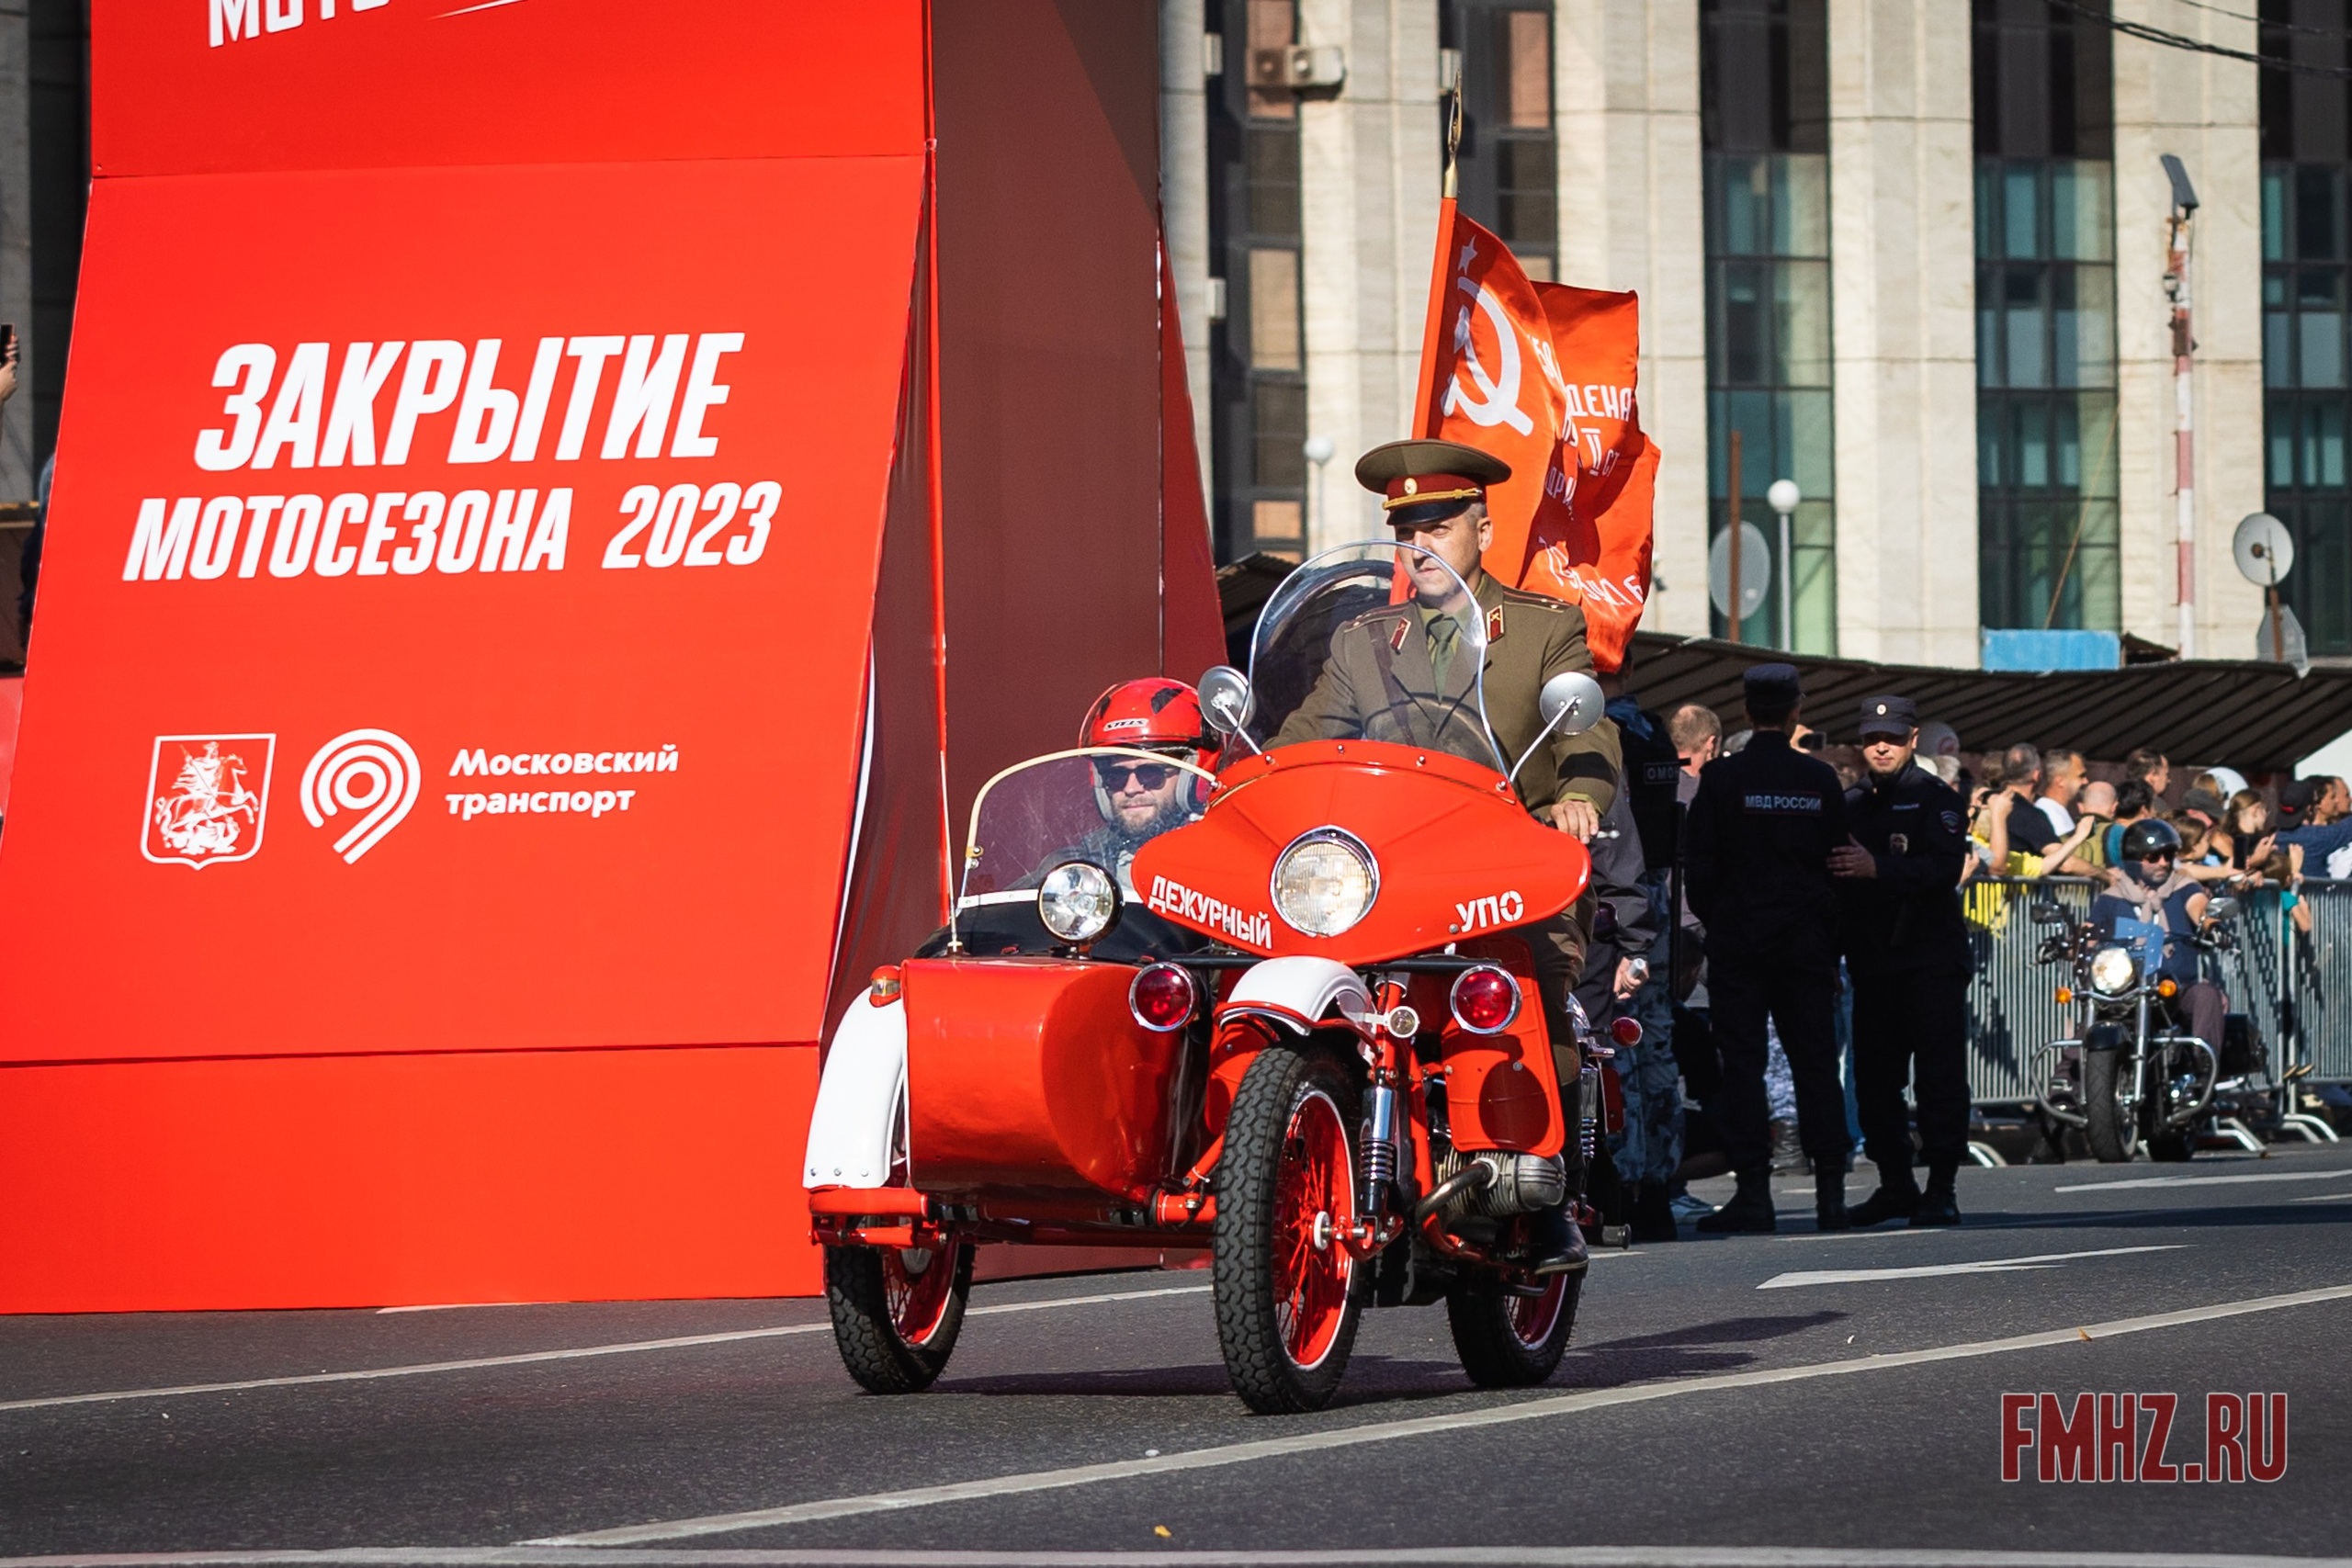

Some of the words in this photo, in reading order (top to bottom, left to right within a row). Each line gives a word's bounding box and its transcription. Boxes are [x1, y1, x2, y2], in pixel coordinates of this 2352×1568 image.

[195, 333, 745, 470] ЗАКРЫТИЕ
[1564, 384, 1632, 423] ДЕНА
[122, 488, 573, 581] МОТОСЕЗОНА
[602, 481, 782, 569] 2023
[449, 744, 678, 777] Московский
[446, 788, 637, 821] транспорт
[1745, 795, 1772, 809] МВД
[1774, 795, 1822, 811] РОССИИ
[1148, 874, 1272, 949] ДЕЖУРНЫЙ
[1455, 890, 1524, 933] УПО
